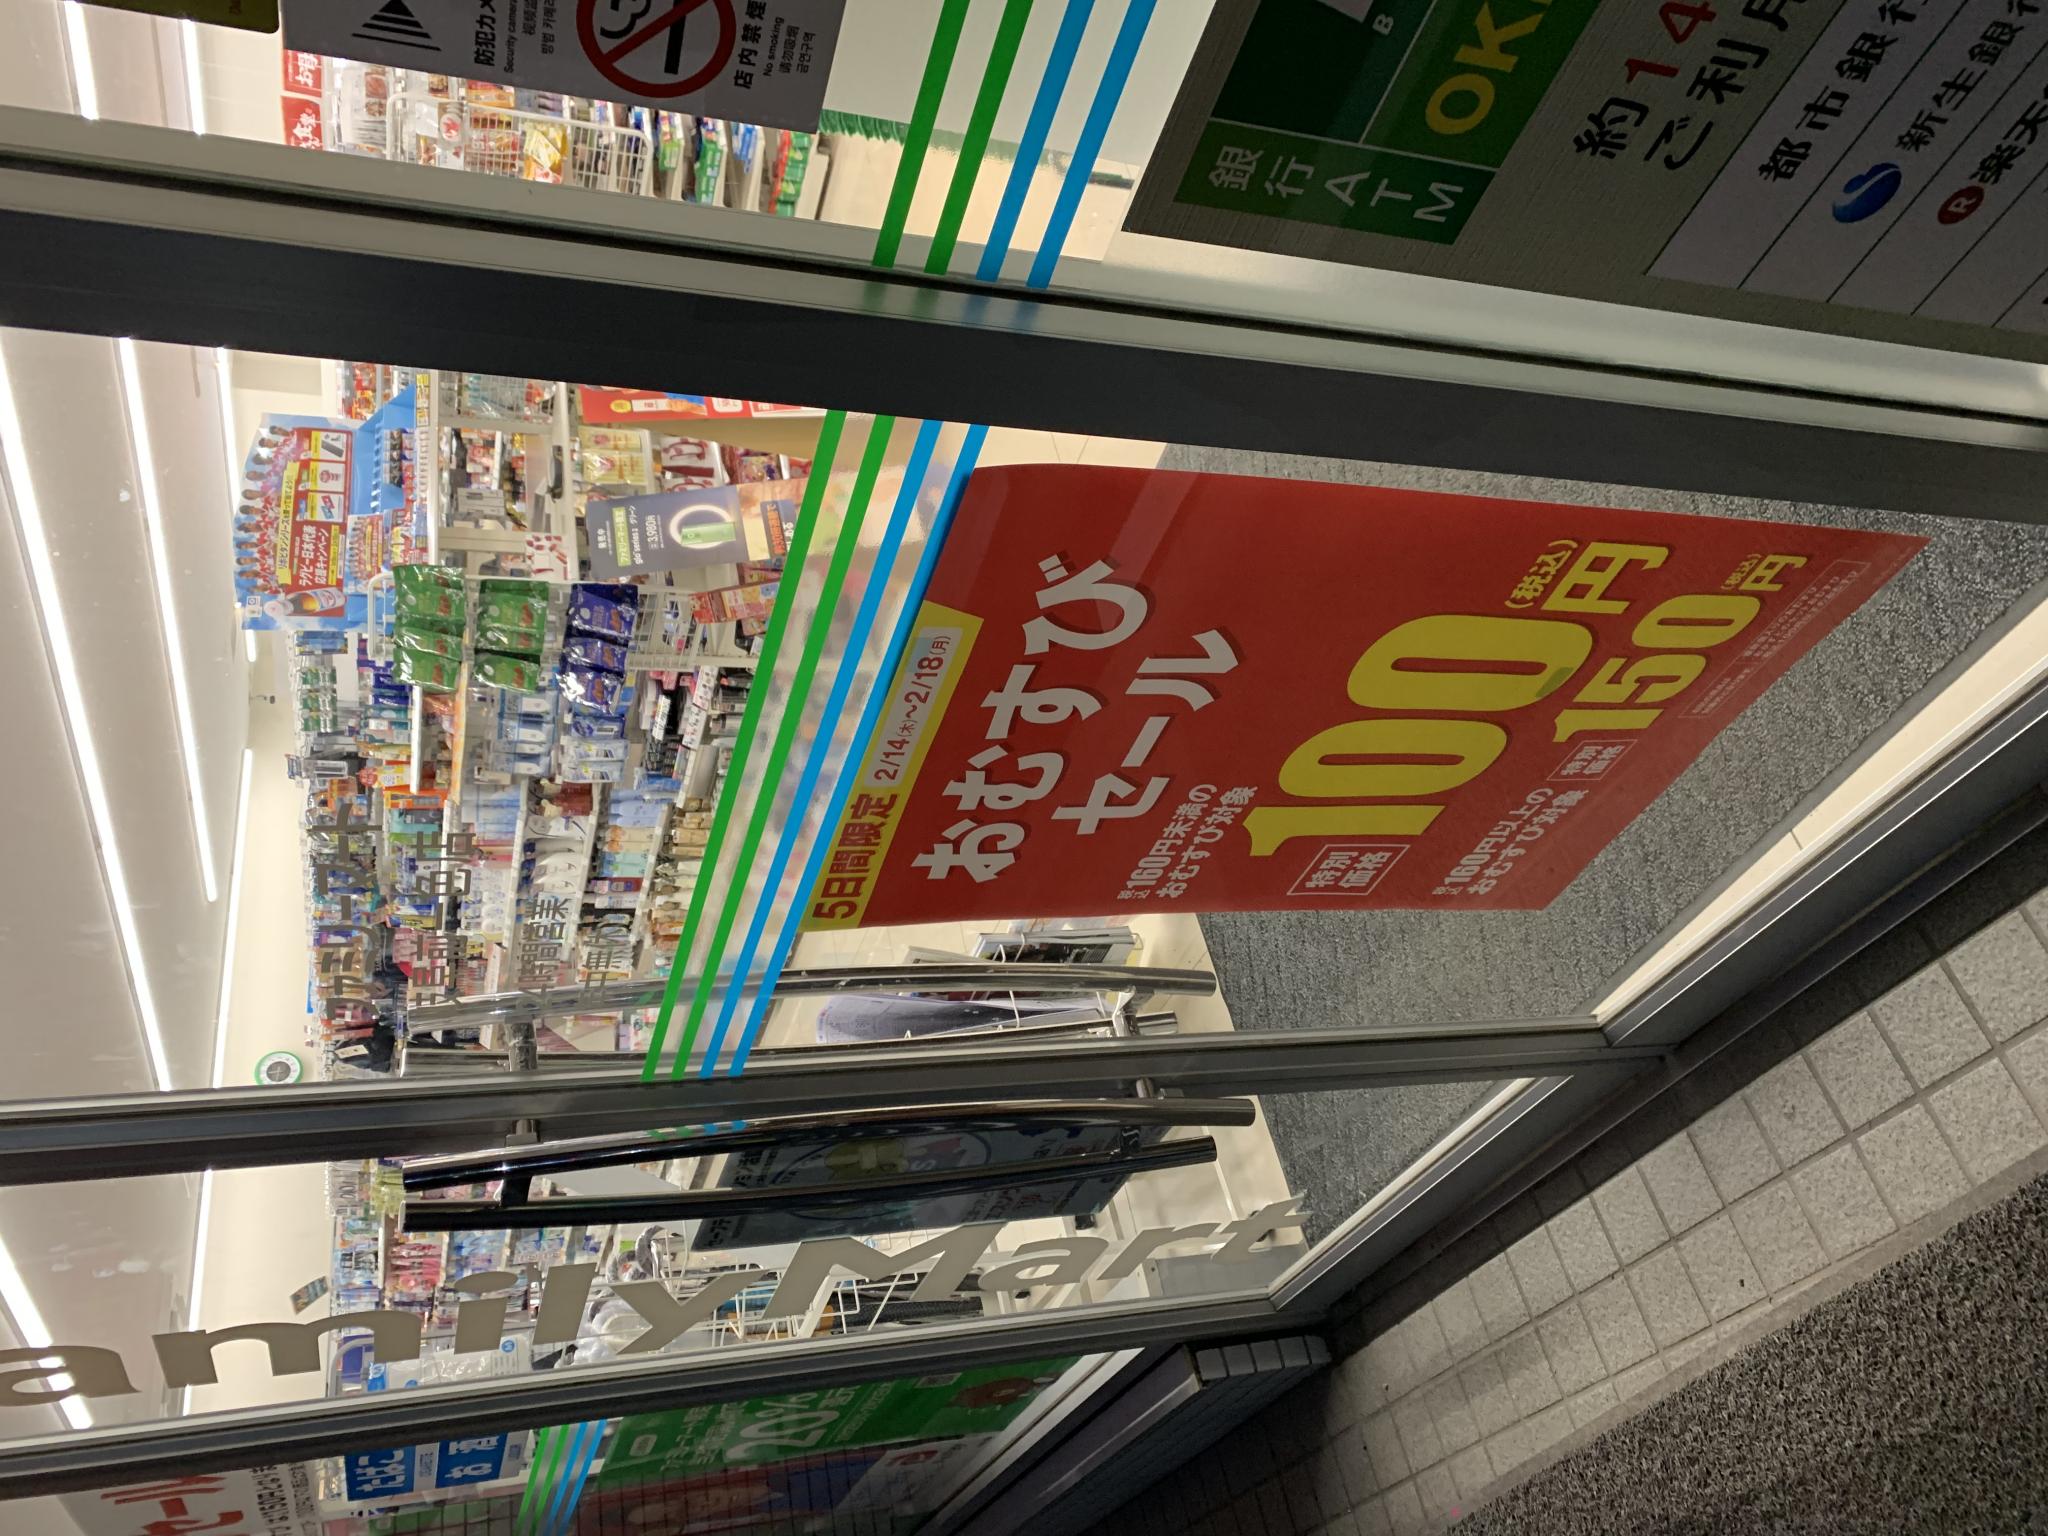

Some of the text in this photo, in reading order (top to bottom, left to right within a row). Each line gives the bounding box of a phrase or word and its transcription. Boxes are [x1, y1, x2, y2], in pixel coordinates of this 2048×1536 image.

[473, 0, 497, 67] 防犯カメ
[503, 35, 518, 74] Security
[733, 0, 767, 89] 店内禁煙
[763, 17, 784, 77] No smoking
[778, 24, 800, 74] 请勿吸烟
[796, 31, 816, 74] 금연구역
[1423, 0, 1554, 135] OK
[1967, 81, 2048, 185] 楽天
[1207, 145, 1465, 224] 銀行ATM
[298, 524, 317, 587] ラグビー日本代表
[314, 527, 329, 585] 応援キャンペーン
[1551, 594, 1762, 743] 150
[1738, 554, 1807, 592] 円
[910, 552, 1148, 884] おむすび
[1050, 629, 1239, 835] セール
[1242, 539, 1669, 858] 100 (税込) 円
[1561, 745, 1603, 775] 特別
[1582, 745, 1625, 775] 価格
[813, 792, 899, 920] 5日間限定
[1127, 783, 1217, 889] 160円未満の
[1156, 786, 1258, 898] おむすび対象
[1303, 850, 1356, 889] 特別
[1339, 850, 1395, 889] 価格
[1444, 787, 1554, 885] 160円以上の
[1467, 788, 1589, 895] おむすび対象
[305, 803, 388, 1020] ファミリーマート
[443, 1434, 500, 1480] お酒
[722, 1392, 840, 1461] 20%
[354, 1449, 409, 1493] たばこ
